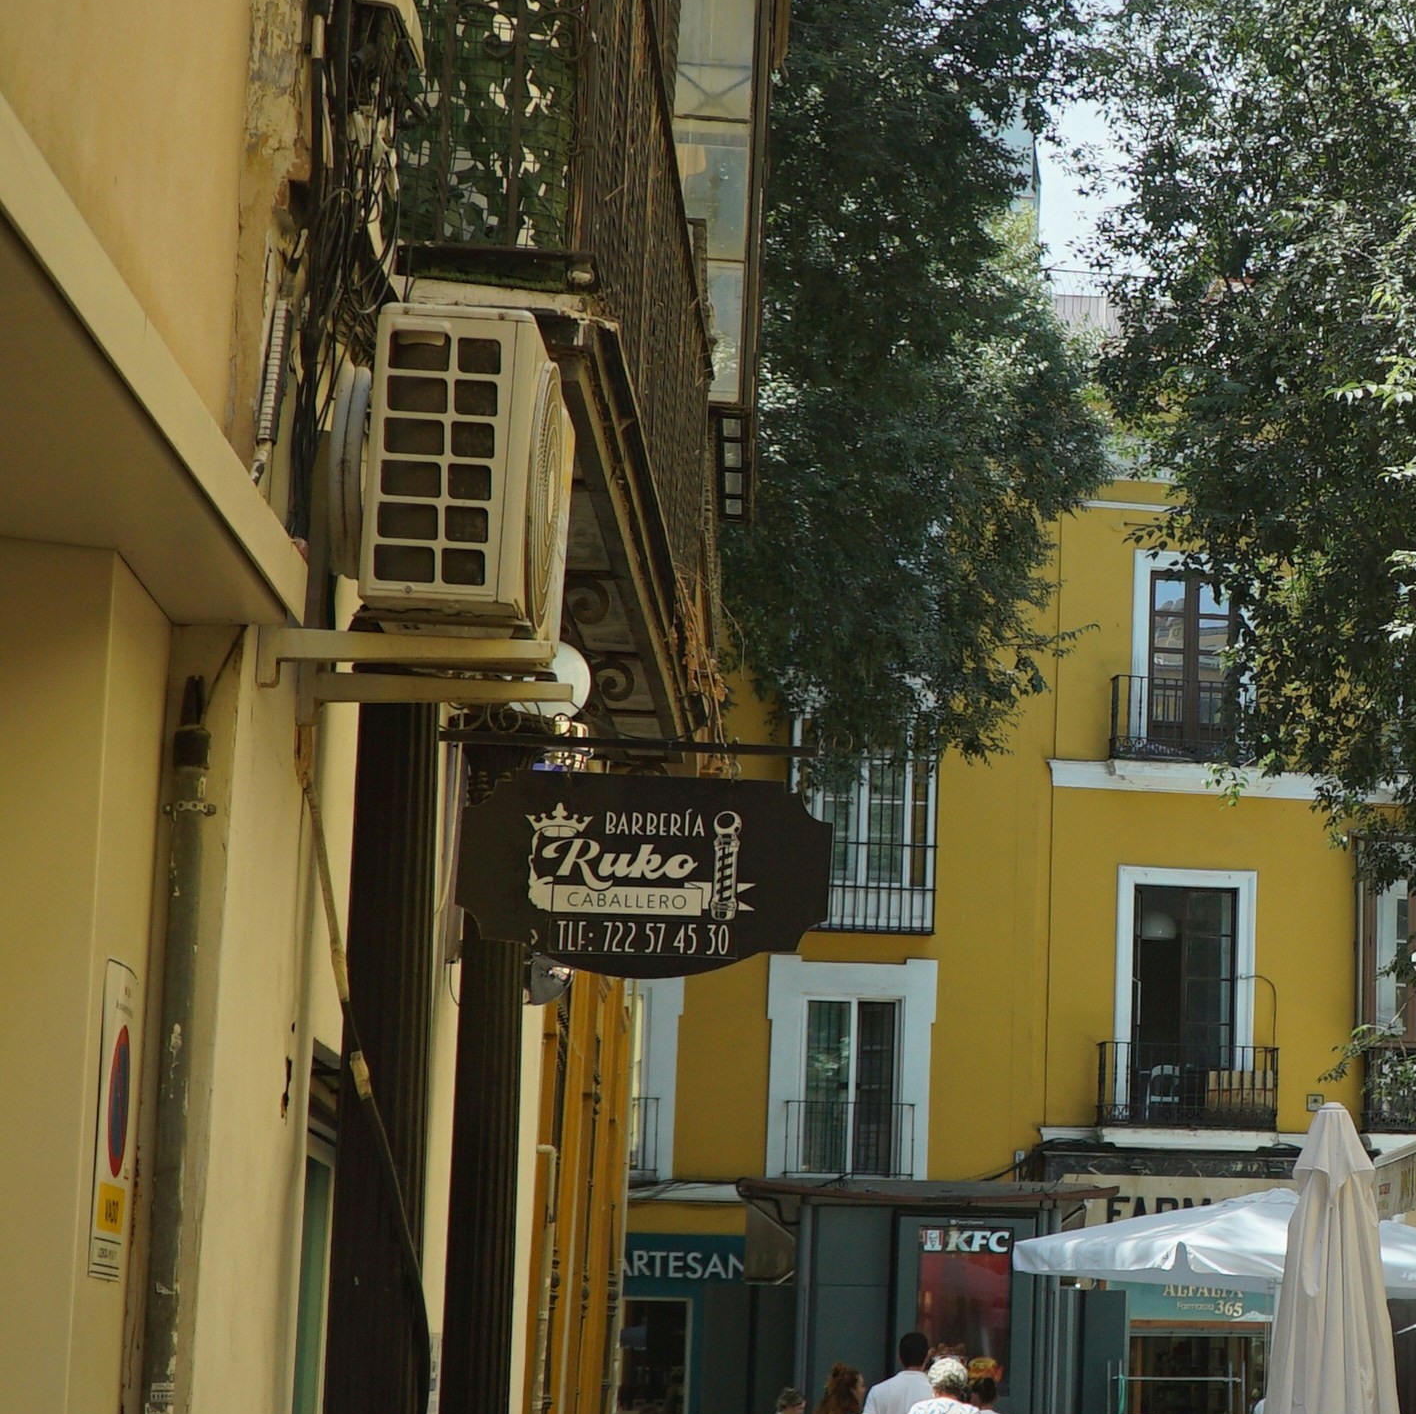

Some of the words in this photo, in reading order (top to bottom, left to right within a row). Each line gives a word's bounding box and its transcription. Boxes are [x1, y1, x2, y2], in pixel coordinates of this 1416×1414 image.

[604, 808, 706, 837] BARBERÍA
[541, 837, 698, 891] Ruko
[566, 890, 688, 911] CABALLERO
[557, 920, 594, 953] TLF:
[603, 922, 635, 953] 722
[644, 923, 666, 954] 57
[672, 924, 698, 955] 45
[706, 924, 730, 956] 30
[945, 1230, 1011, 1254] KFC
[1214, 1299, 1244, 1318] 365
